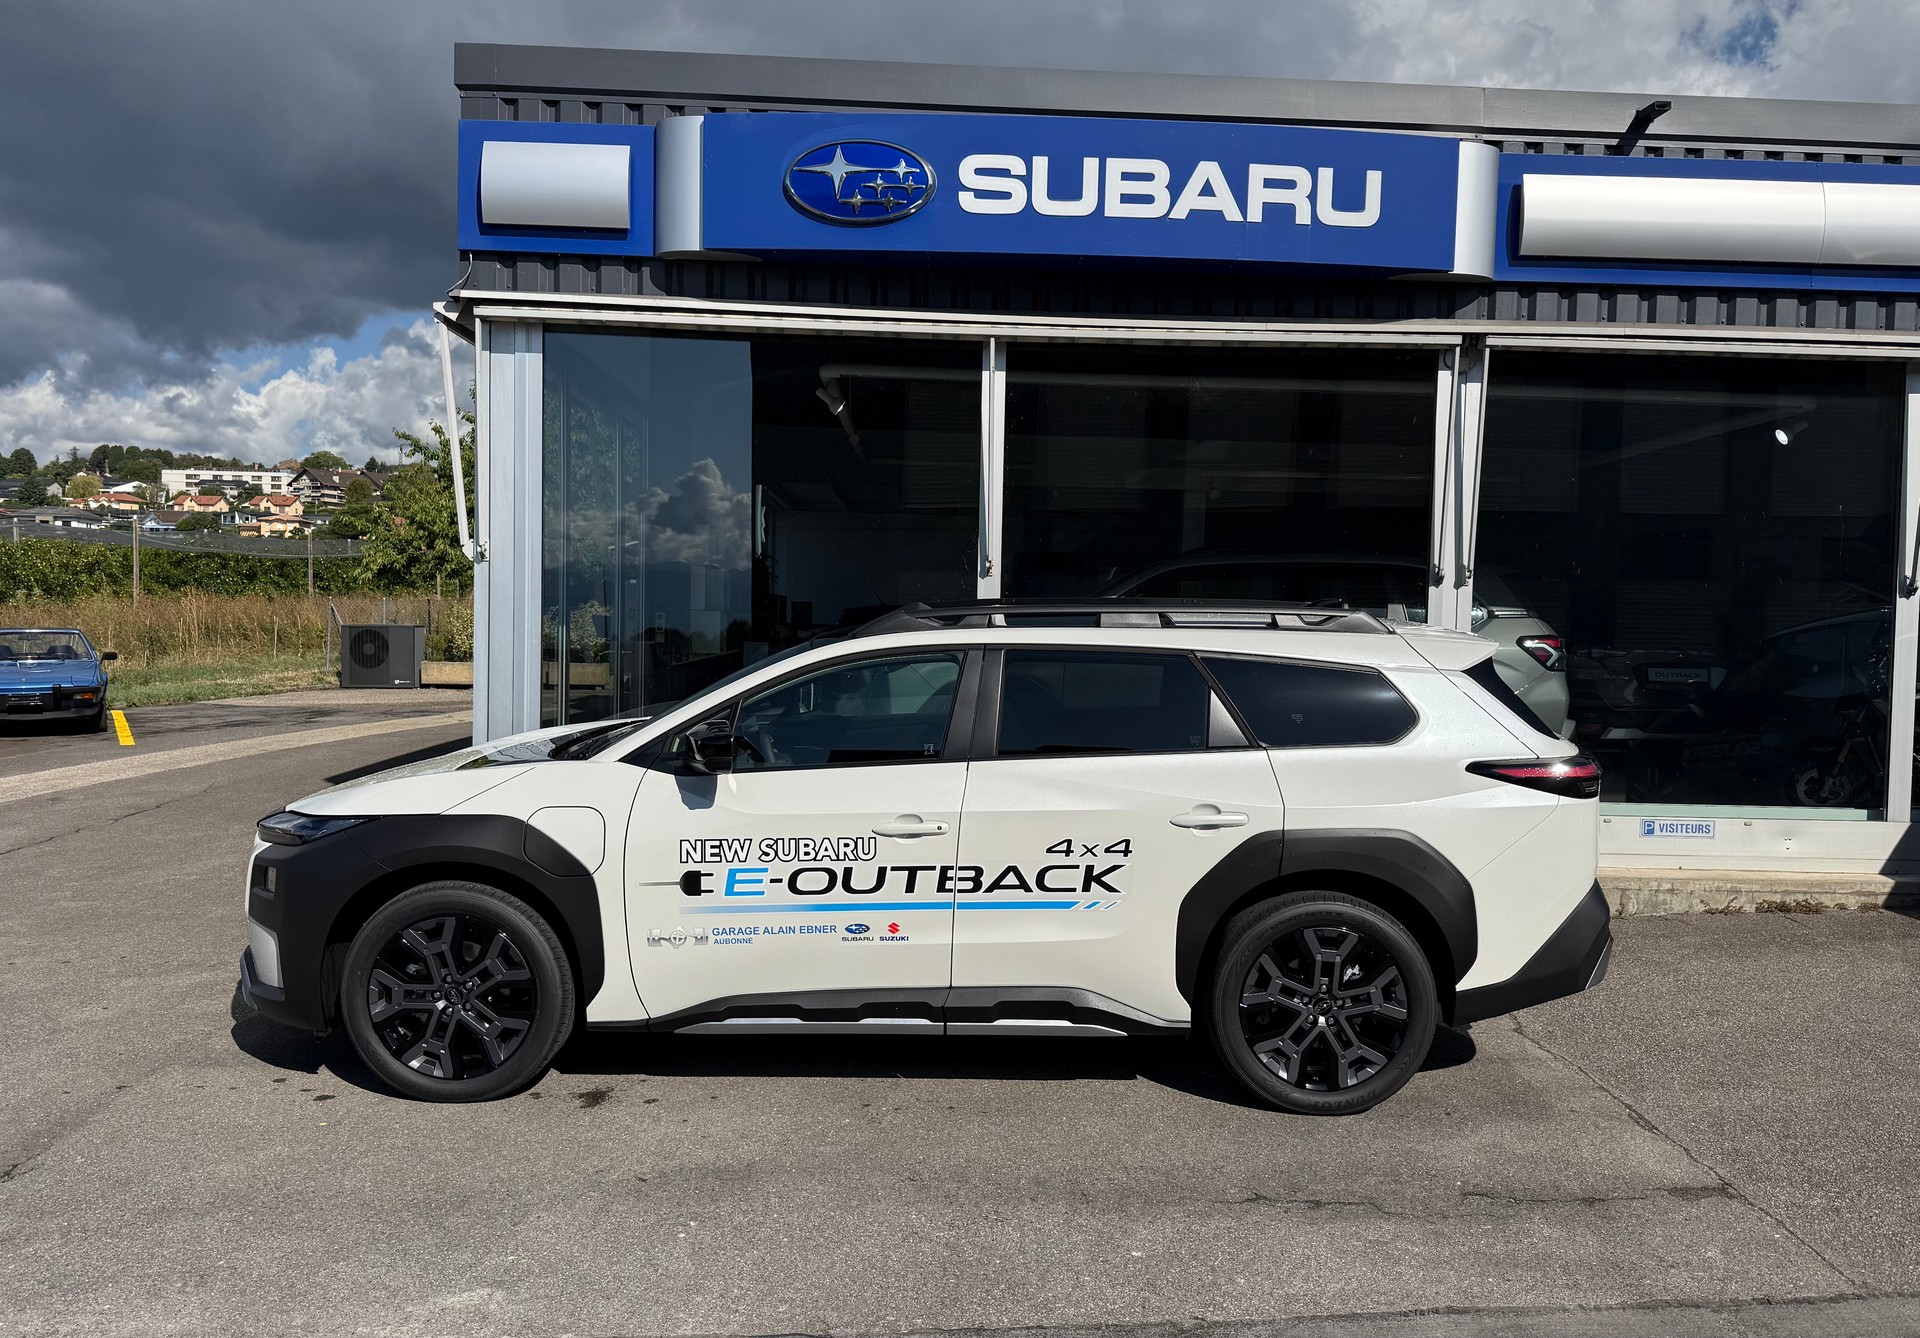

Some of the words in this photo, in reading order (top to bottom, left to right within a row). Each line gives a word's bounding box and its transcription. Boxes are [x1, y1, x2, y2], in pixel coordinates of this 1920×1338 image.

[958, 153, 1382, 228] SUBARU
[1658, 823, 1711, 834] VISITEURS
[680, 838, 752, 863] NEW
[758, 837, 877, 863] SUBARU
[724, 864, 1127, 897] E-OUTBACK
[711, 926, 760, 936] GARAGE
[762, 926, 796, 935] ALAIN
[799, 925, 837, 934] EBNER
[713, 937, 753, 945] AUBONNE
